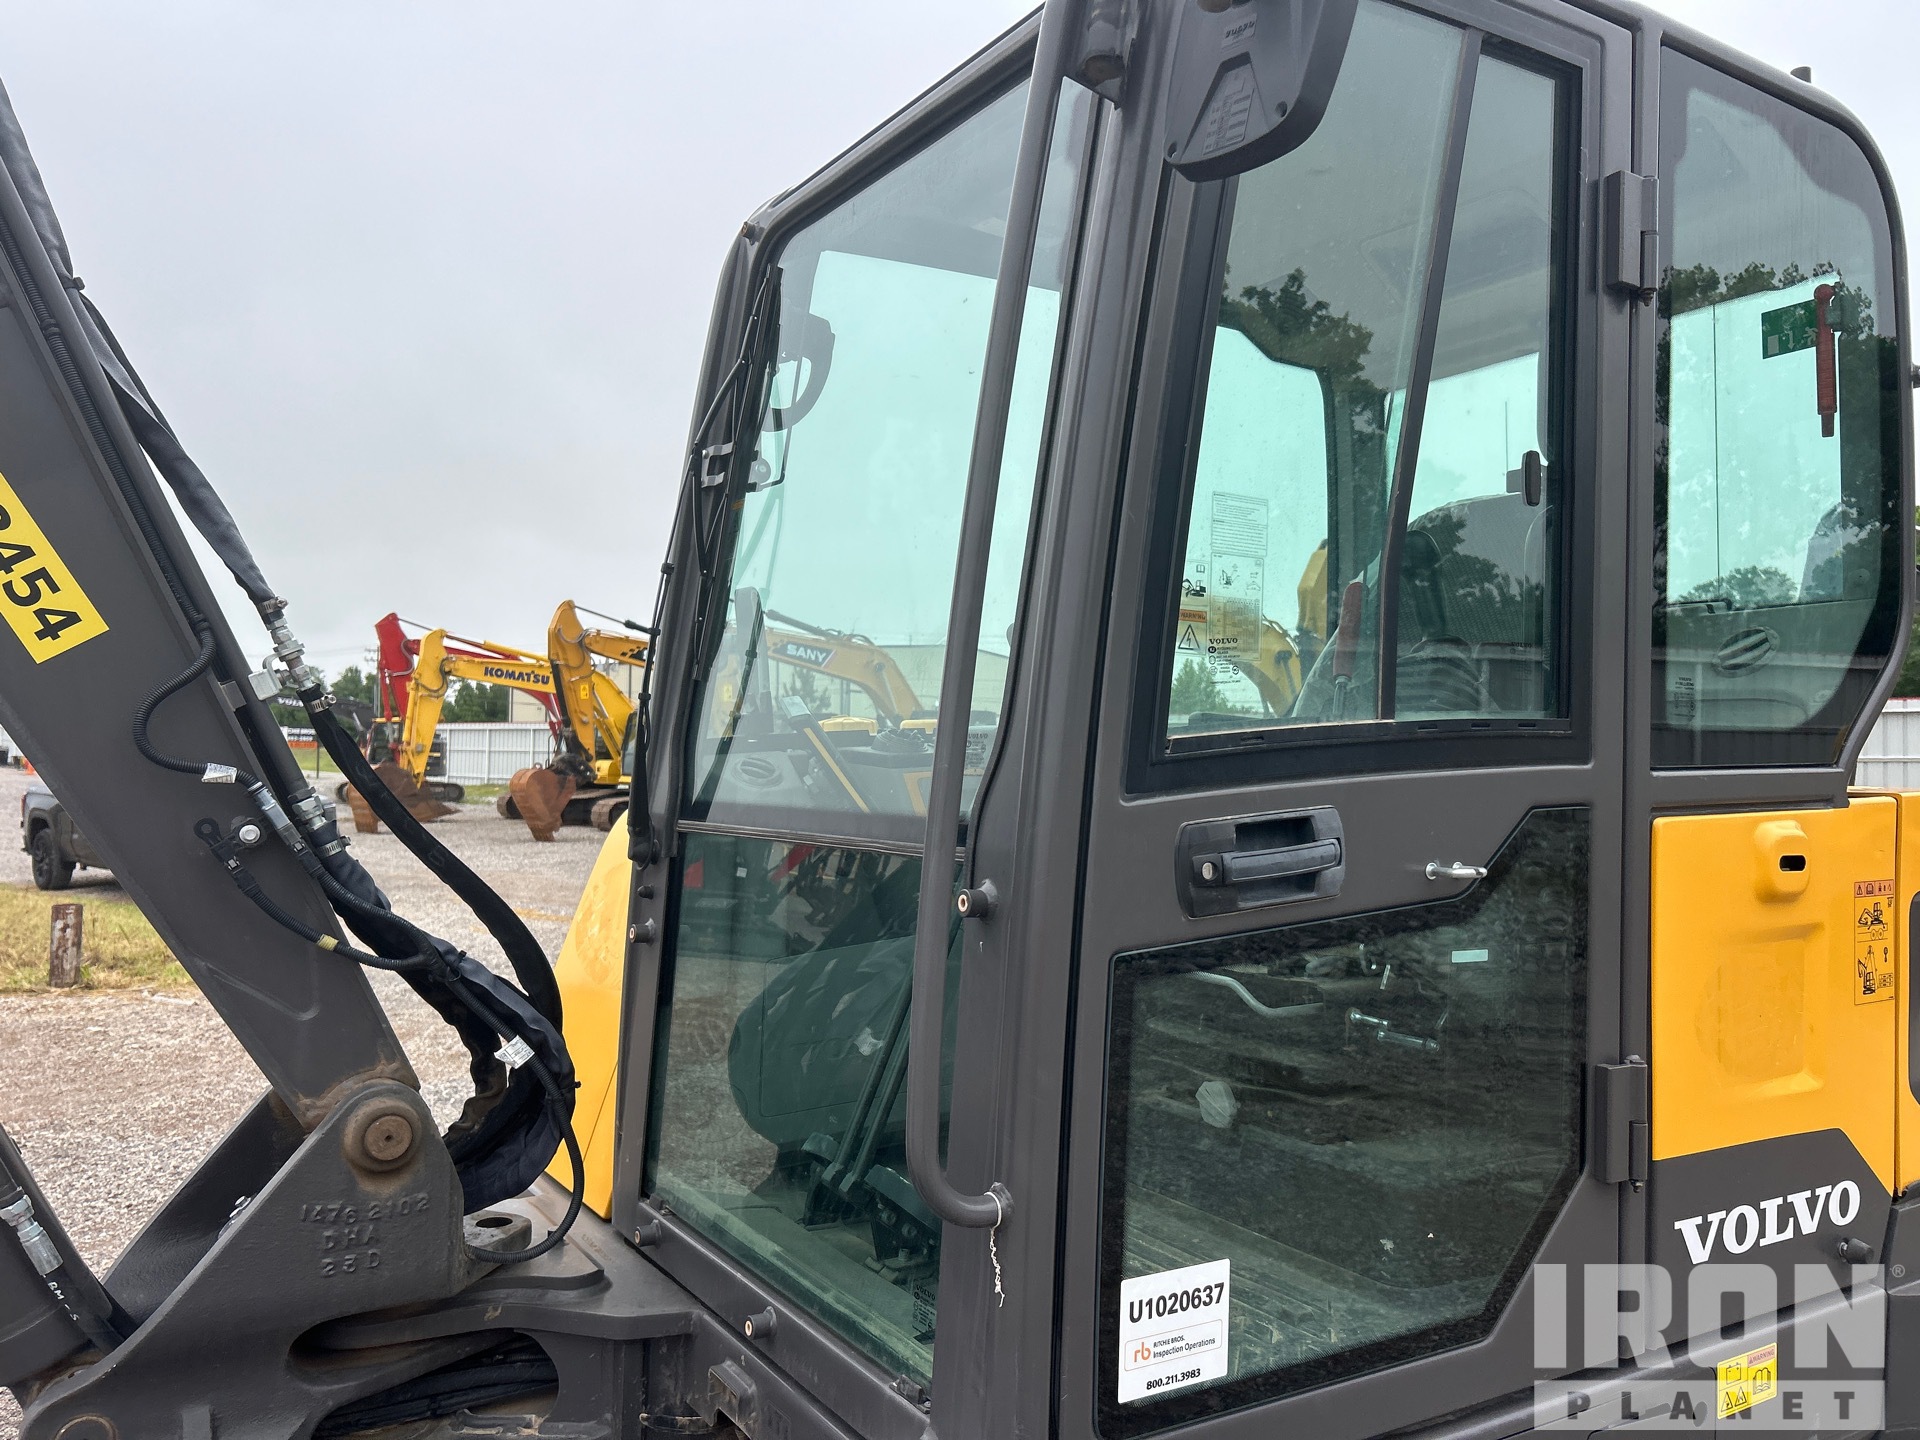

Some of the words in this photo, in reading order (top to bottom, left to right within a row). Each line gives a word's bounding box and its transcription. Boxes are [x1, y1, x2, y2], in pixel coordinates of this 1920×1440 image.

[1209, 637, 1238, 645] VOLVO
[786, 643, 827, 663] SANY
[484, 666, 550, 685] KOMATSU
[1674, 1180, 1861, 1265] VOLVO
[1129, 1282, 1225, 1323] U1020637
[1134, 1341, 1152, 1363] rb
[1153, 1338, 1170, 1348] RITCHIE
[1153, 1345, 1184, 1359] Inspection
[1184, 1337, 1216, 1352] Operations
[1752, 1348, 1775, 1362] WARNING
[1146, 1367, 1201, 1391] 800.211.3983
